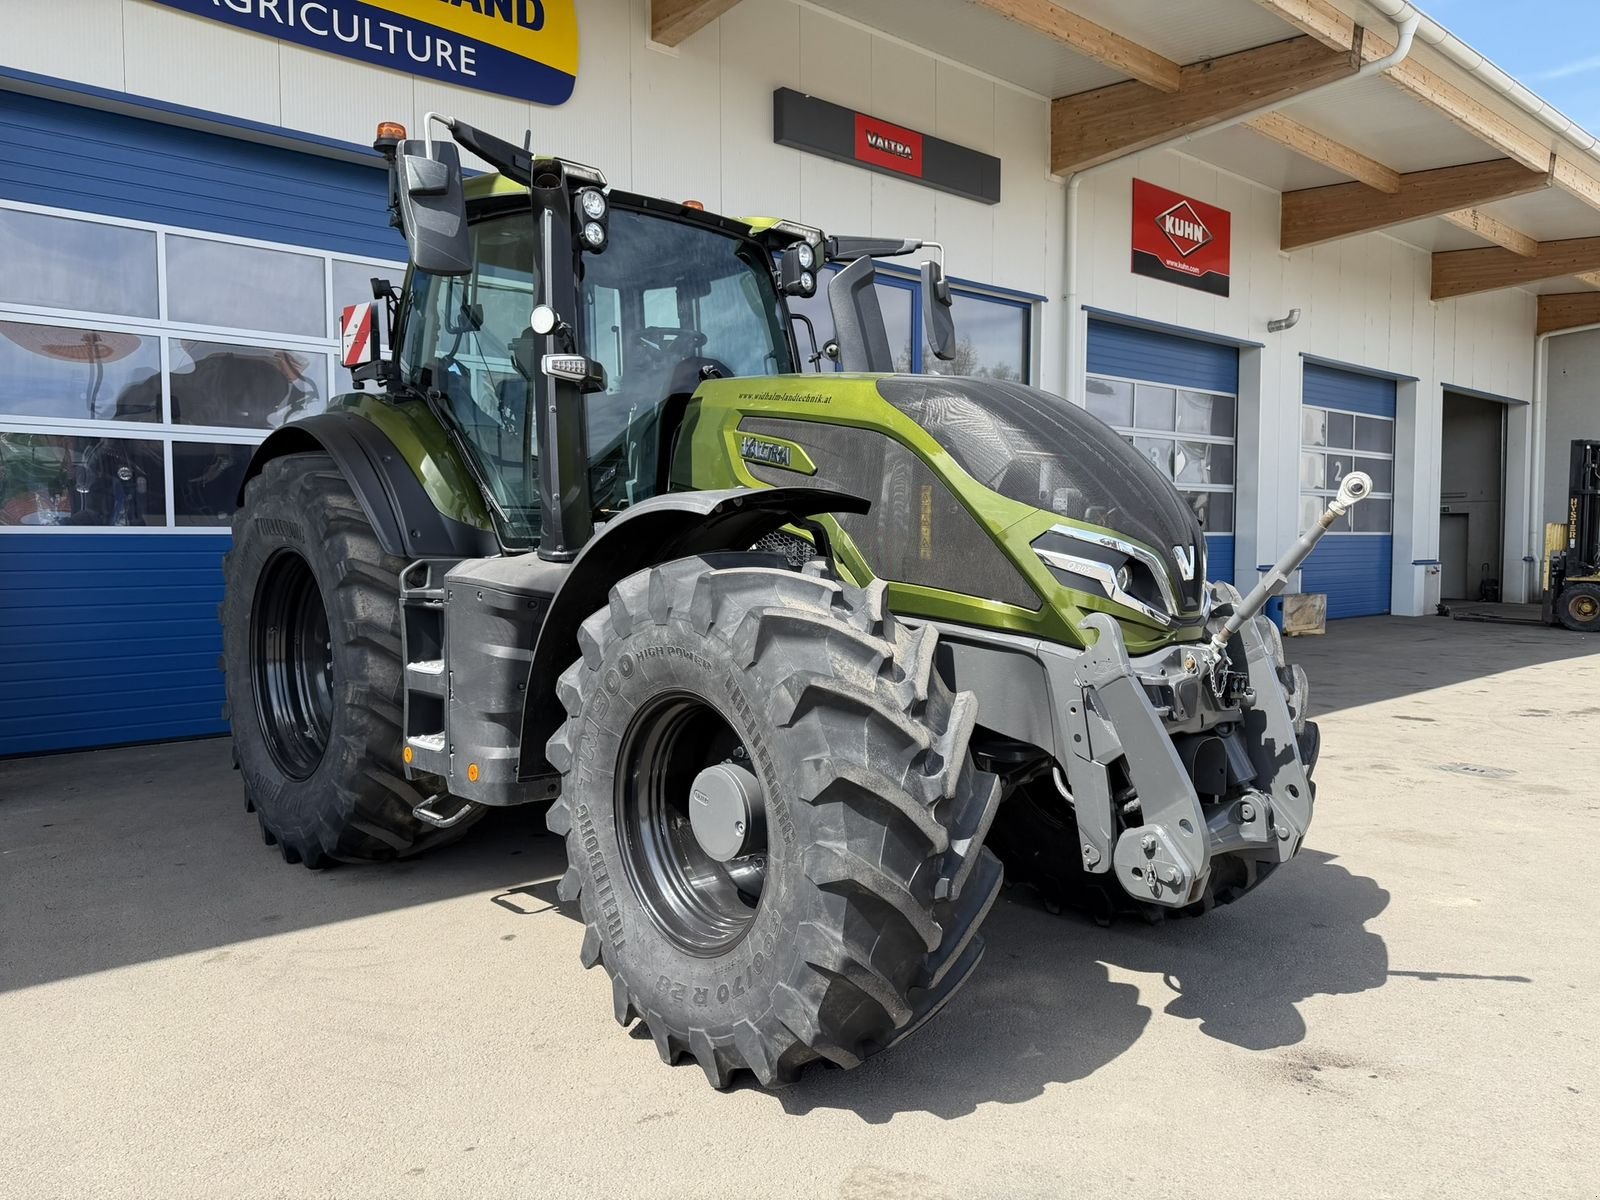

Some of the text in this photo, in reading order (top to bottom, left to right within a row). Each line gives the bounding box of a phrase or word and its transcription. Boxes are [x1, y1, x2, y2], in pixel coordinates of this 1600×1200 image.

[212, 0, 477, 77] GRICULTURE
[865, 131, 913, 160] VALTRA
[1165, 214, 1203, 243] KUHN
[1165, 258, 1200, 274] www.kuhn.com
[1334, 461, 1342, 482] 2
[1569, 497, 1578, 539] HYSTER
[635, 645, 665, 663] HIGH
[666, 645, 713, 673] POWER
[574, 803, 627, 953] TRELLEBORG
